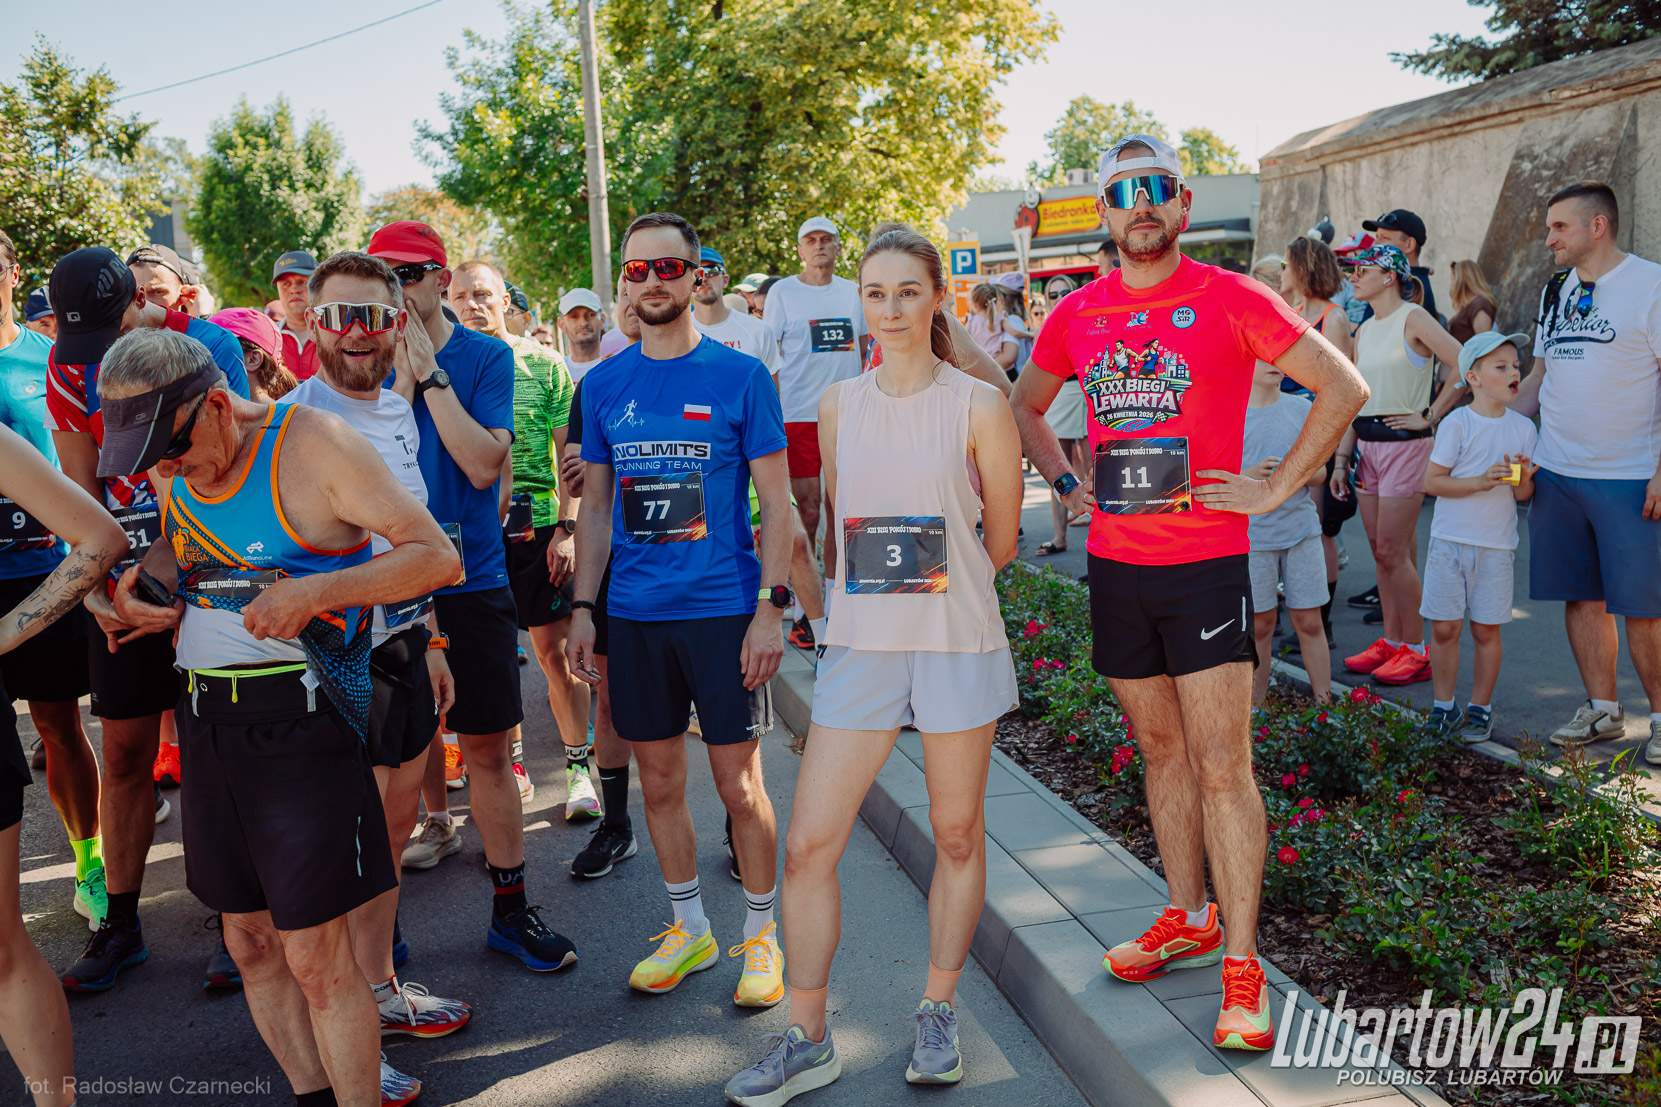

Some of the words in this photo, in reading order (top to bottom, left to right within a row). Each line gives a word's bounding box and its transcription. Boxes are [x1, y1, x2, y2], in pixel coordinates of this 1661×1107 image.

[956, 250, 973, 273] P
[822, 329, 845, 341] 132
[1553, 347, 1585, 356] FAMOUS
[1099, 380, 1125, 396] XXX
[1126, 378, 1165, 393] BIEGI
[1091, 390, 1177, 415] LEWARTA
[1114, 411, 1138, 419] KWIETNIA
[1138, 410, 1154, 418] 2026
[615, 443, 708, 459] NOLIMITS
[616, 461, 661, 472] RUNNING
[665, 461, 702, 470] TEAM
[1121, 466, 1152, 488] 11
[643, 499, 671, 520] 77
[12, 511, 26, 530] 9
[886, 544, 902, 567] 3
